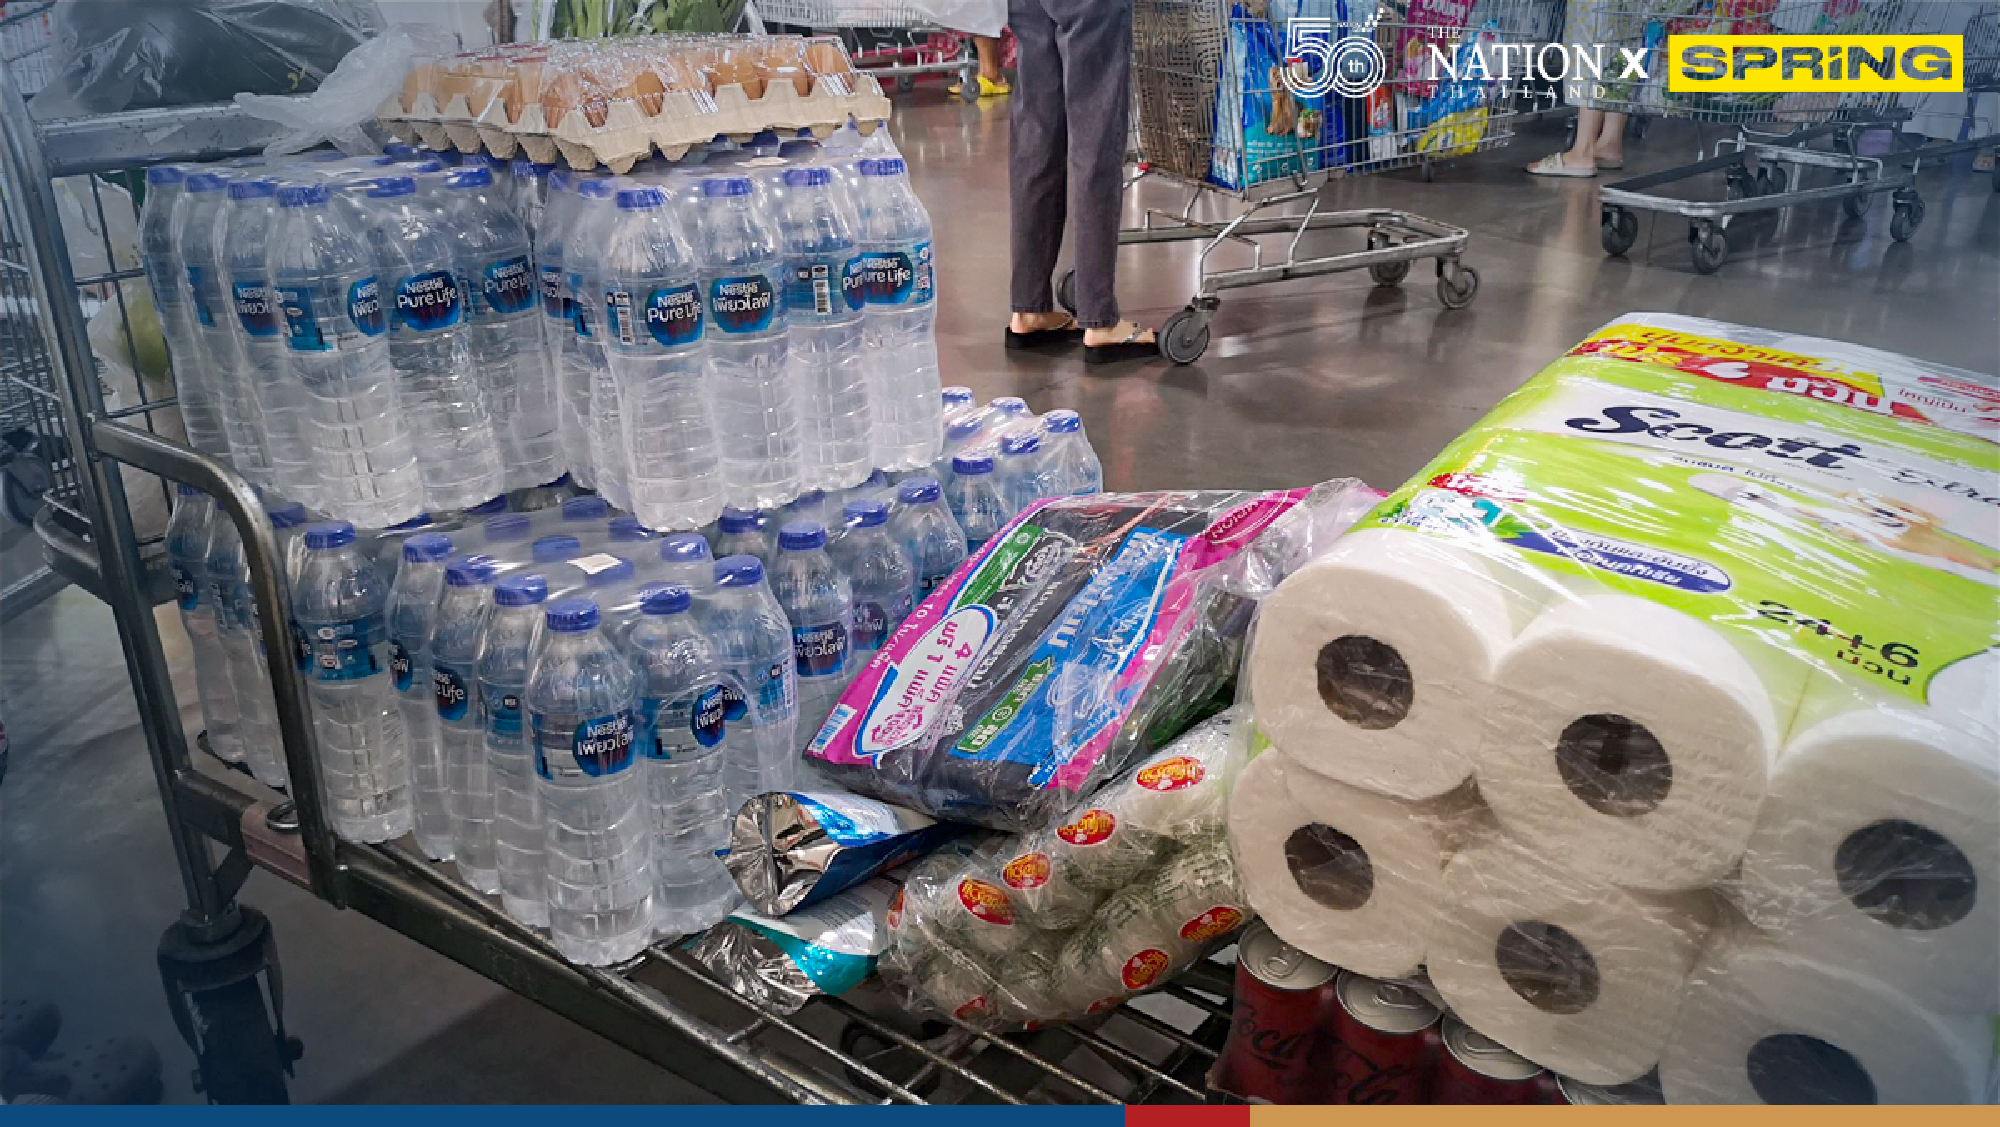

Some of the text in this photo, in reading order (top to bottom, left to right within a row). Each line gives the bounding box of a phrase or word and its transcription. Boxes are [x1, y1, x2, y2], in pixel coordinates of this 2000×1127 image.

[396, 286, 458, 309] Pure Life
[647, 306, 684, 323] Pure
[1564, 405, 1868, 471] Scott
[936, 621, 958, 648] ฟรี
[954, 641, 973, 660] 4
[897, 669, 929, 709] แพ็ค
[925, 664, 958, 703] แพ็ค
